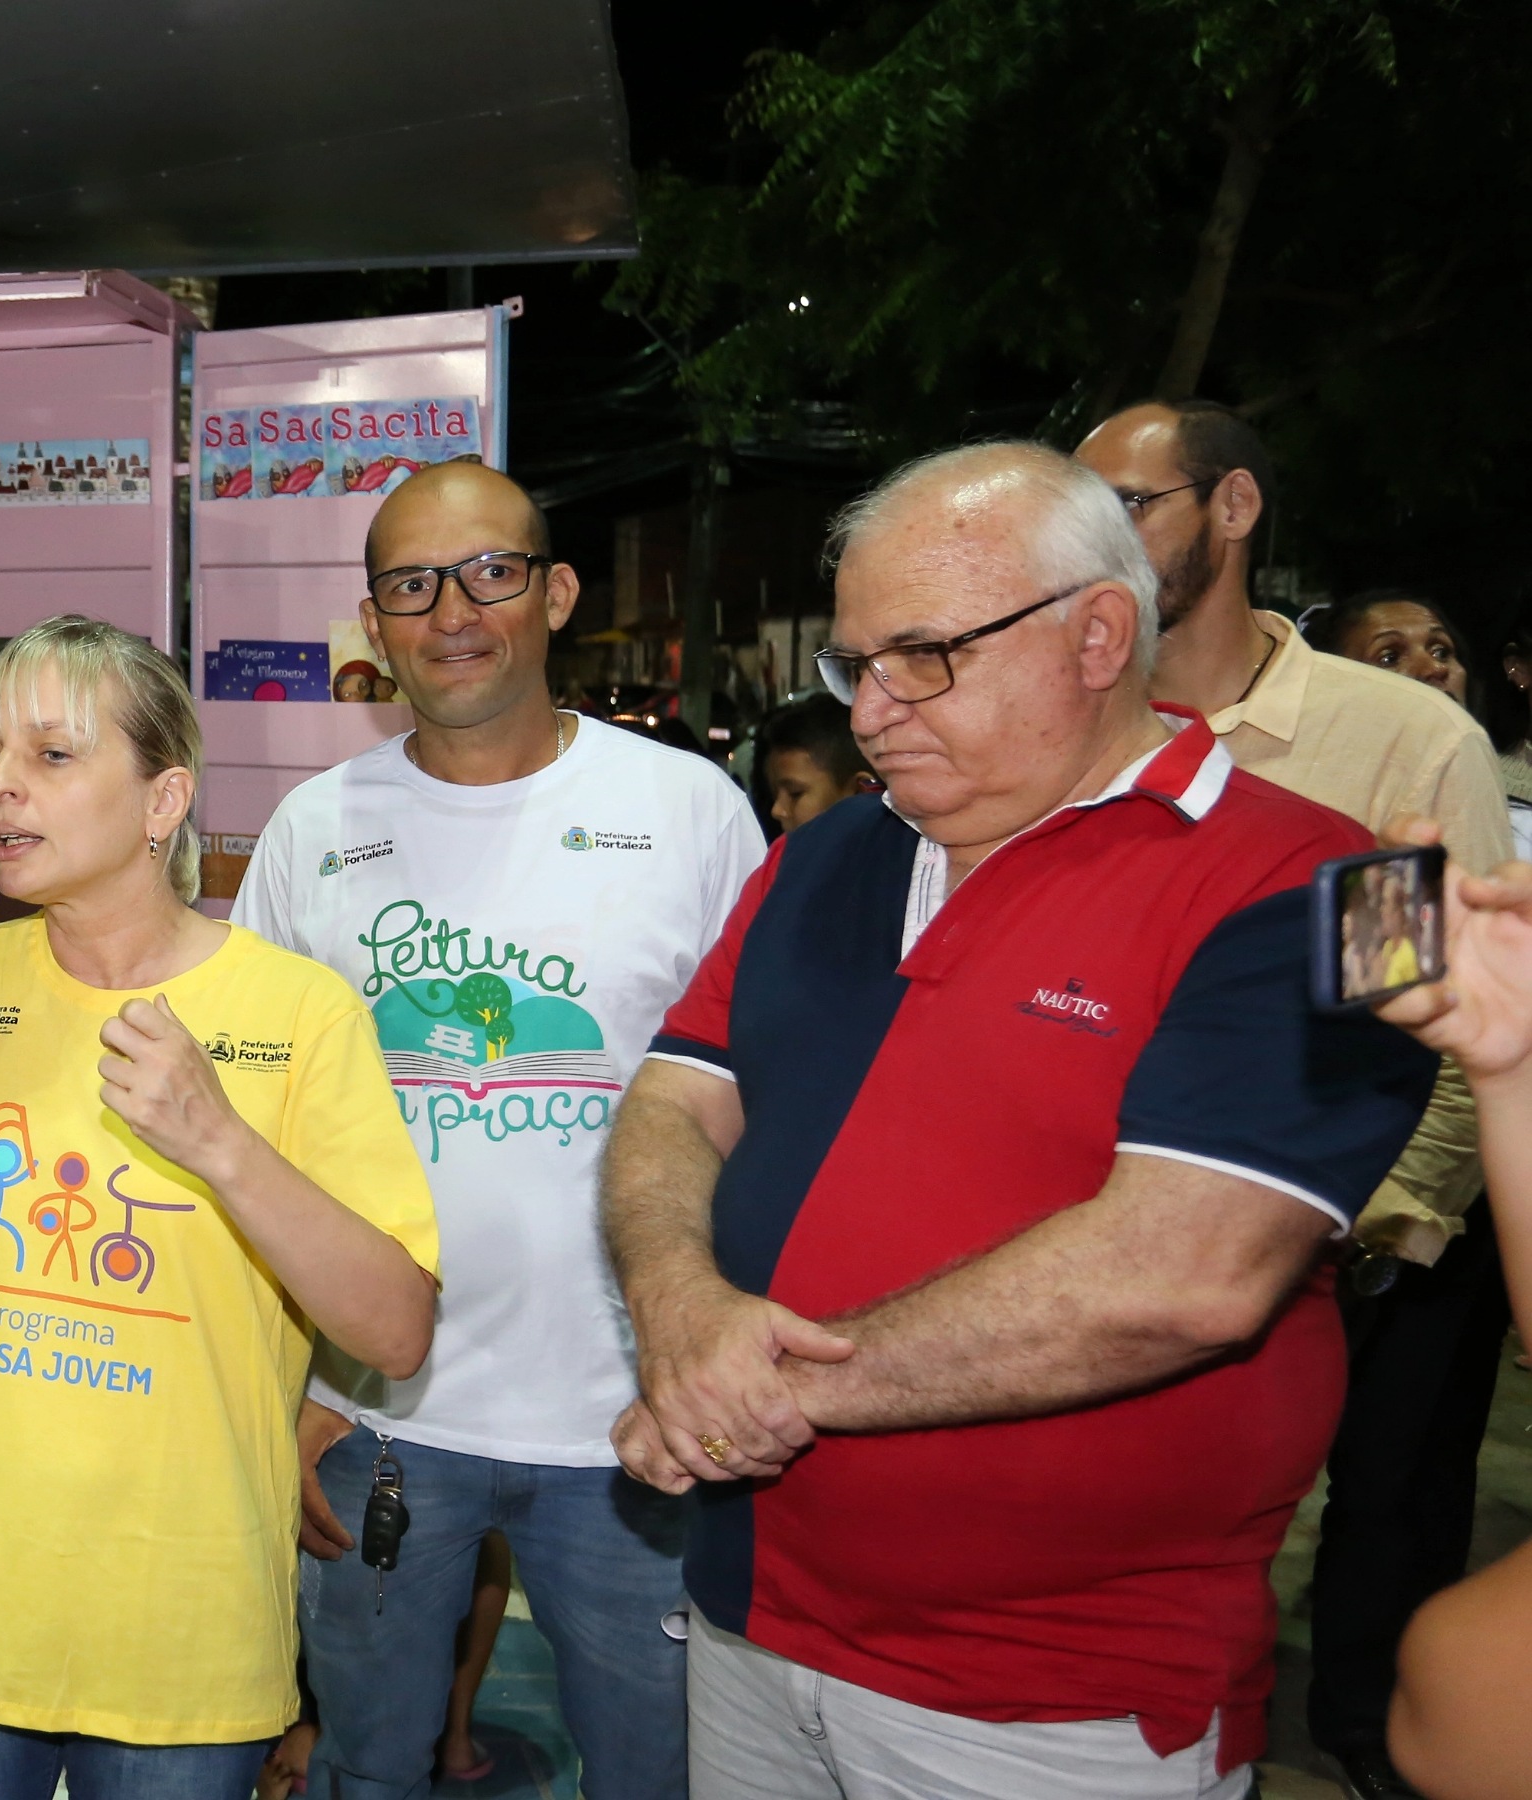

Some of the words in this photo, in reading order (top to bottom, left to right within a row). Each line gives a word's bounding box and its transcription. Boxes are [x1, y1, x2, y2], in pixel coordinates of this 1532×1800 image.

[331, 401, 469, 440] Sacita
[224, 646, 234, 658] A
[237, 647, 276, 661] viagem
[241, 664, 255, 677] de
[595, 832, 638, 841] Prefeitura
[344, 842, 381, 855] Prefeitura
[595, 839, 652, 850] Fortaleza
[344, 848, 393, 866] Fortaleza
[358, 900, 587, 1017] Leitura
[9, 1006, 21, 1014] de
[1031, 988, 1109, 1020] NAUTIC
[240, 1040, 285, 1049] Prefeitura
[287, 1040, 293, 1049] d
[238, 1049, 291, 1062] Fortalez
[427, 1091, 611, 1164] praça
[41, 1351, 152, 1395] JOVEM
